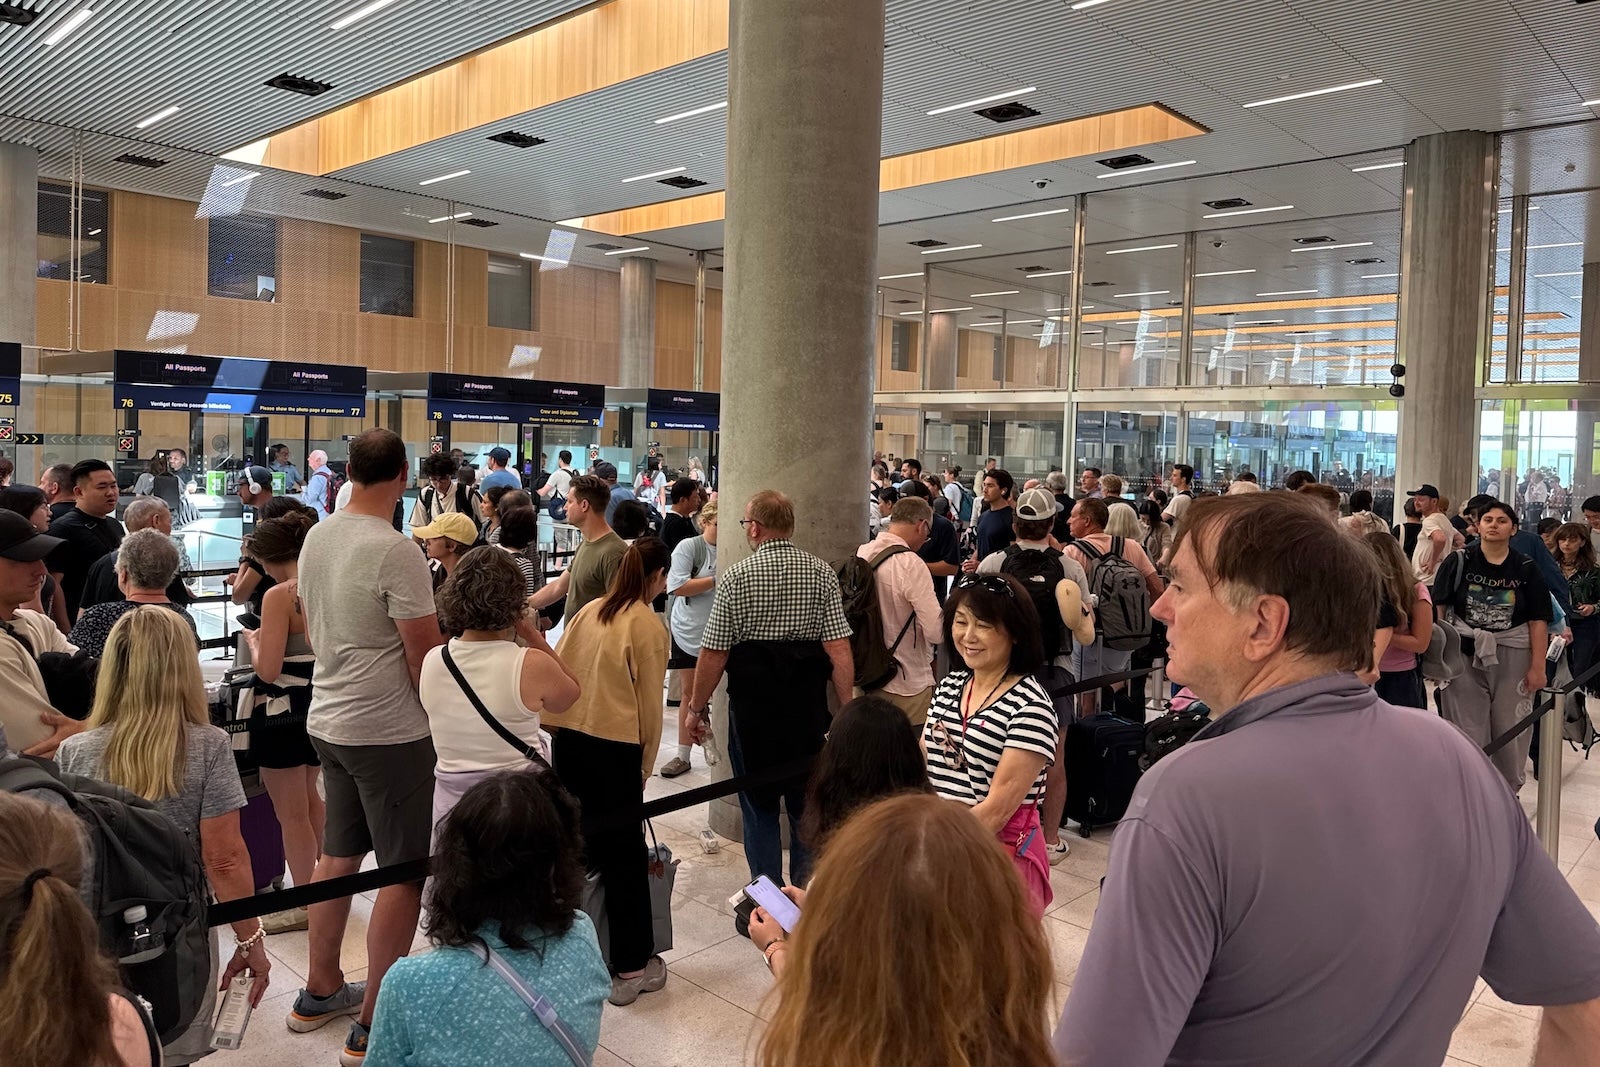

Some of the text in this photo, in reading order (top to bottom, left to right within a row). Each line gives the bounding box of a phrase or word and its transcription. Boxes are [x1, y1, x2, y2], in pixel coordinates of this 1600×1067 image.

[175, 363, 206, 372] Passports
[302, 372, 328, 380] Passports
[0, 393, 12, 403] 75
[121, 399, 134, 407] 76
[350, 407, 361, 416] 77
[433, 411, 443, 420] 78
[1465, 573, 1521, 587] COLDPLAY
